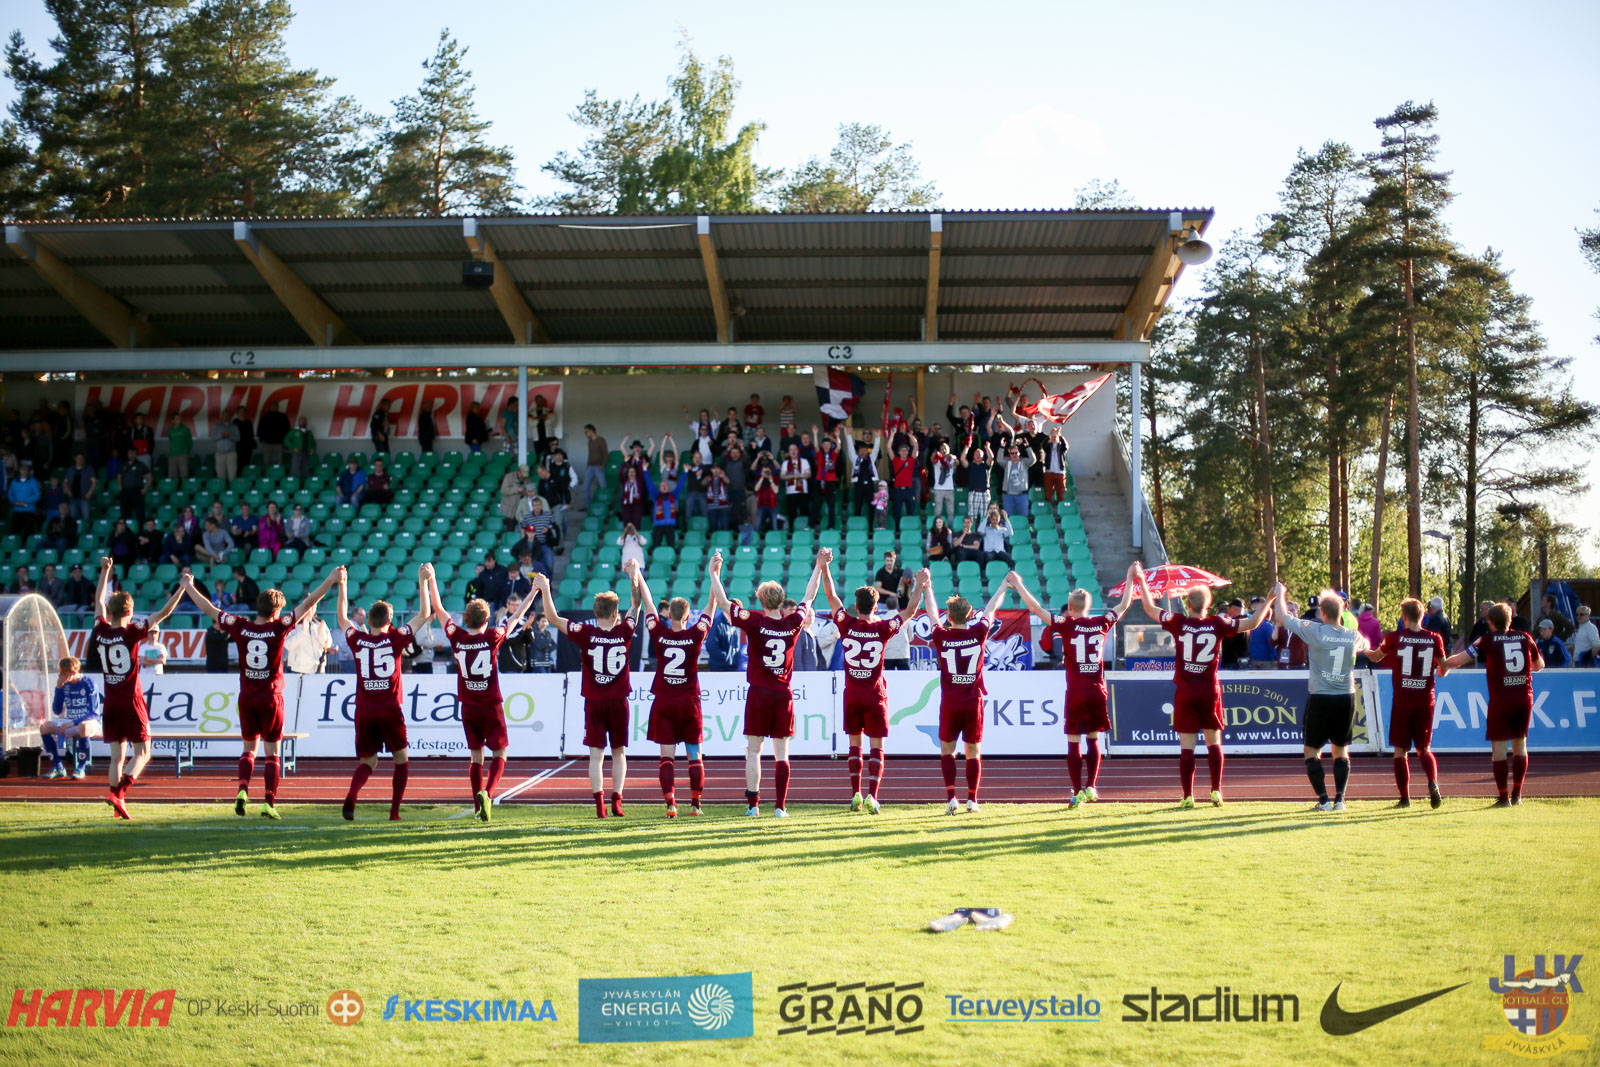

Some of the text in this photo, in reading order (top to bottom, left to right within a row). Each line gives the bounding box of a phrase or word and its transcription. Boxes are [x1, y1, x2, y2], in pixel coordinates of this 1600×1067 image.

[97, 644, 131, 674] 19
[246, 639, 268, 669] 8
[355, 646, 396, 679] 15
[587, 645, 627, 675] 16
[663, 647, 686, 676] 2
[762, 638, 786, 668] 3
[842, 638, 884, 669] 23
[940, 645, 982, 675] 17
[1070, 634, 1105, 663] 13
[1179, 633, 1217, 663] 12
[1329, 646, 1345, 676] 1
[1397, 646, 1434, 677] 11
[1503, 642, 1525, 673] 5
[454, 650, 493, 679] 14
[1263, 689, 1290, 706] 2001
